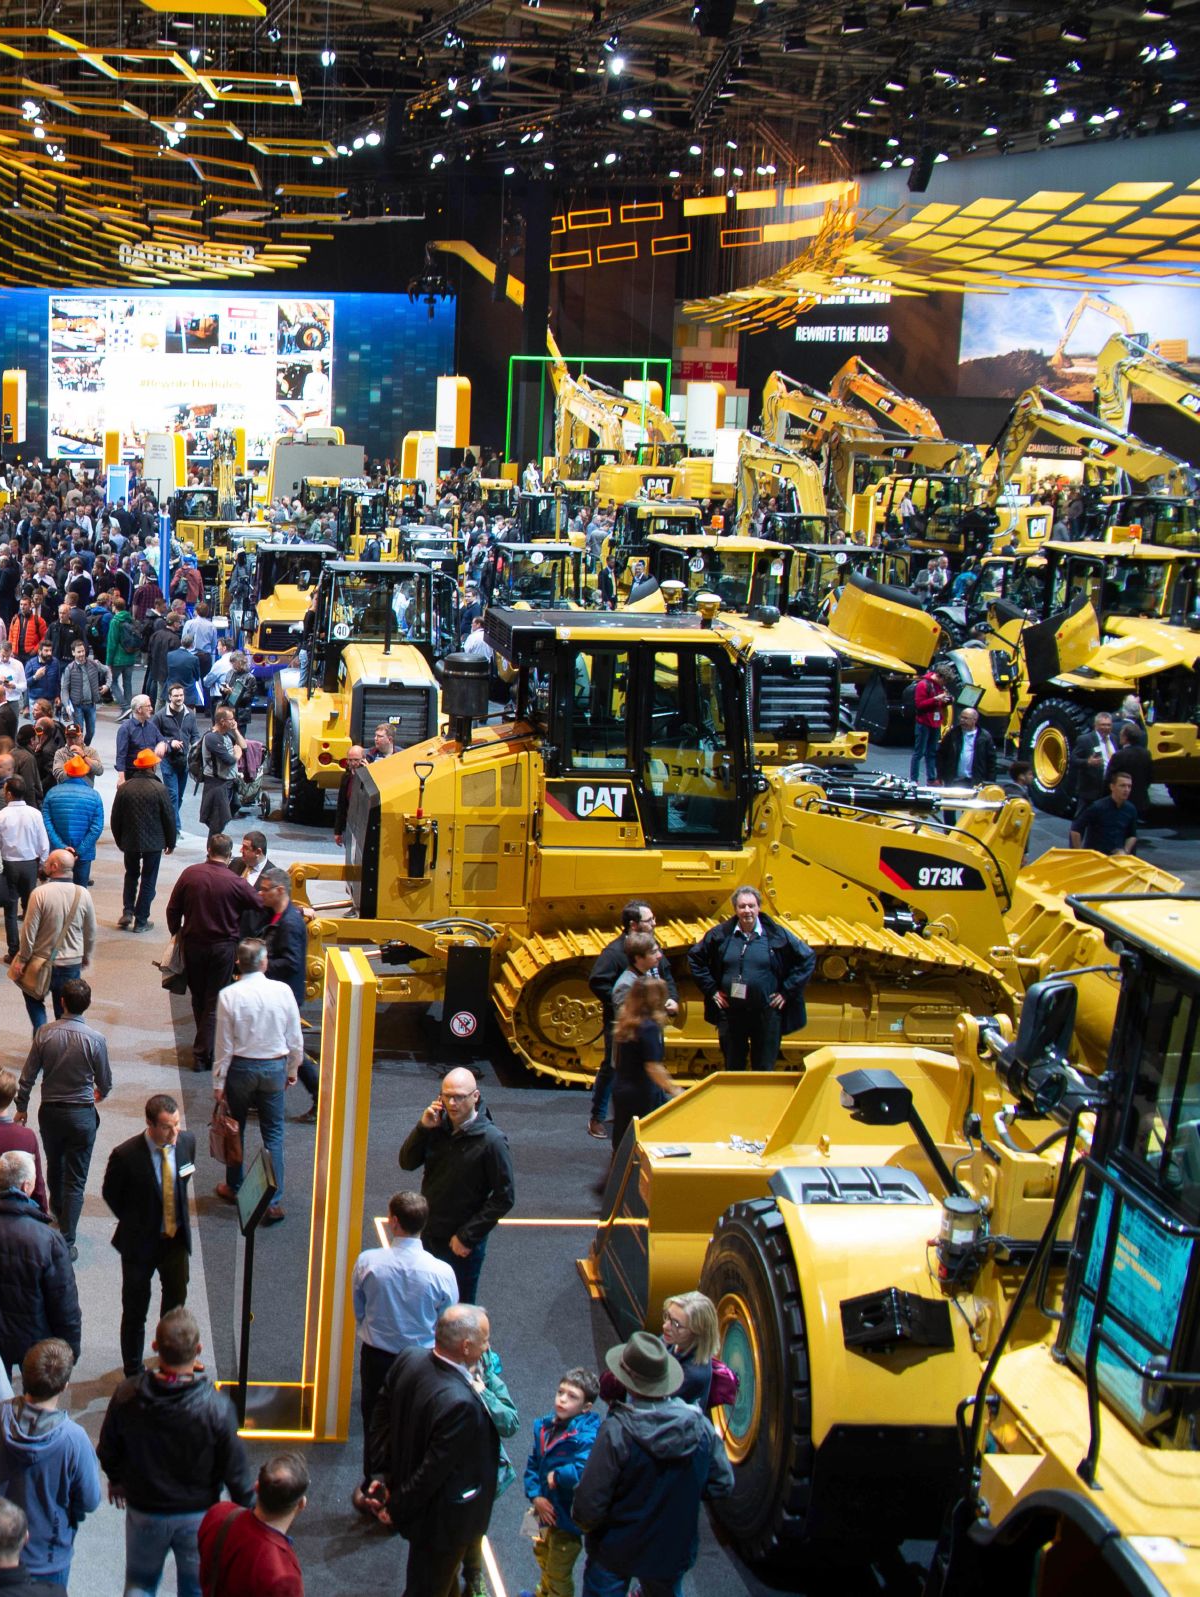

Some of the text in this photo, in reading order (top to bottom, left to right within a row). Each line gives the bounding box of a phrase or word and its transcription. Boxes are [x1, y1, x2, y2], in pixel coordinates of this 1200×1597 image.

[796, 325, 890, 342] REWRITE THE RULES
[878, 398, 892, 412] CAT
[810, 408, 823, 421] CAT
[1059, 445, 1083, 456] CENTRE
[1090, 438, 1108, 454] CAT
[646, 478, 671, 496] CAT
[1030, 518, 1047, 538] CAT
[577, 786, 628, 818] CAT
[918, 867, 964, 886] 973K
